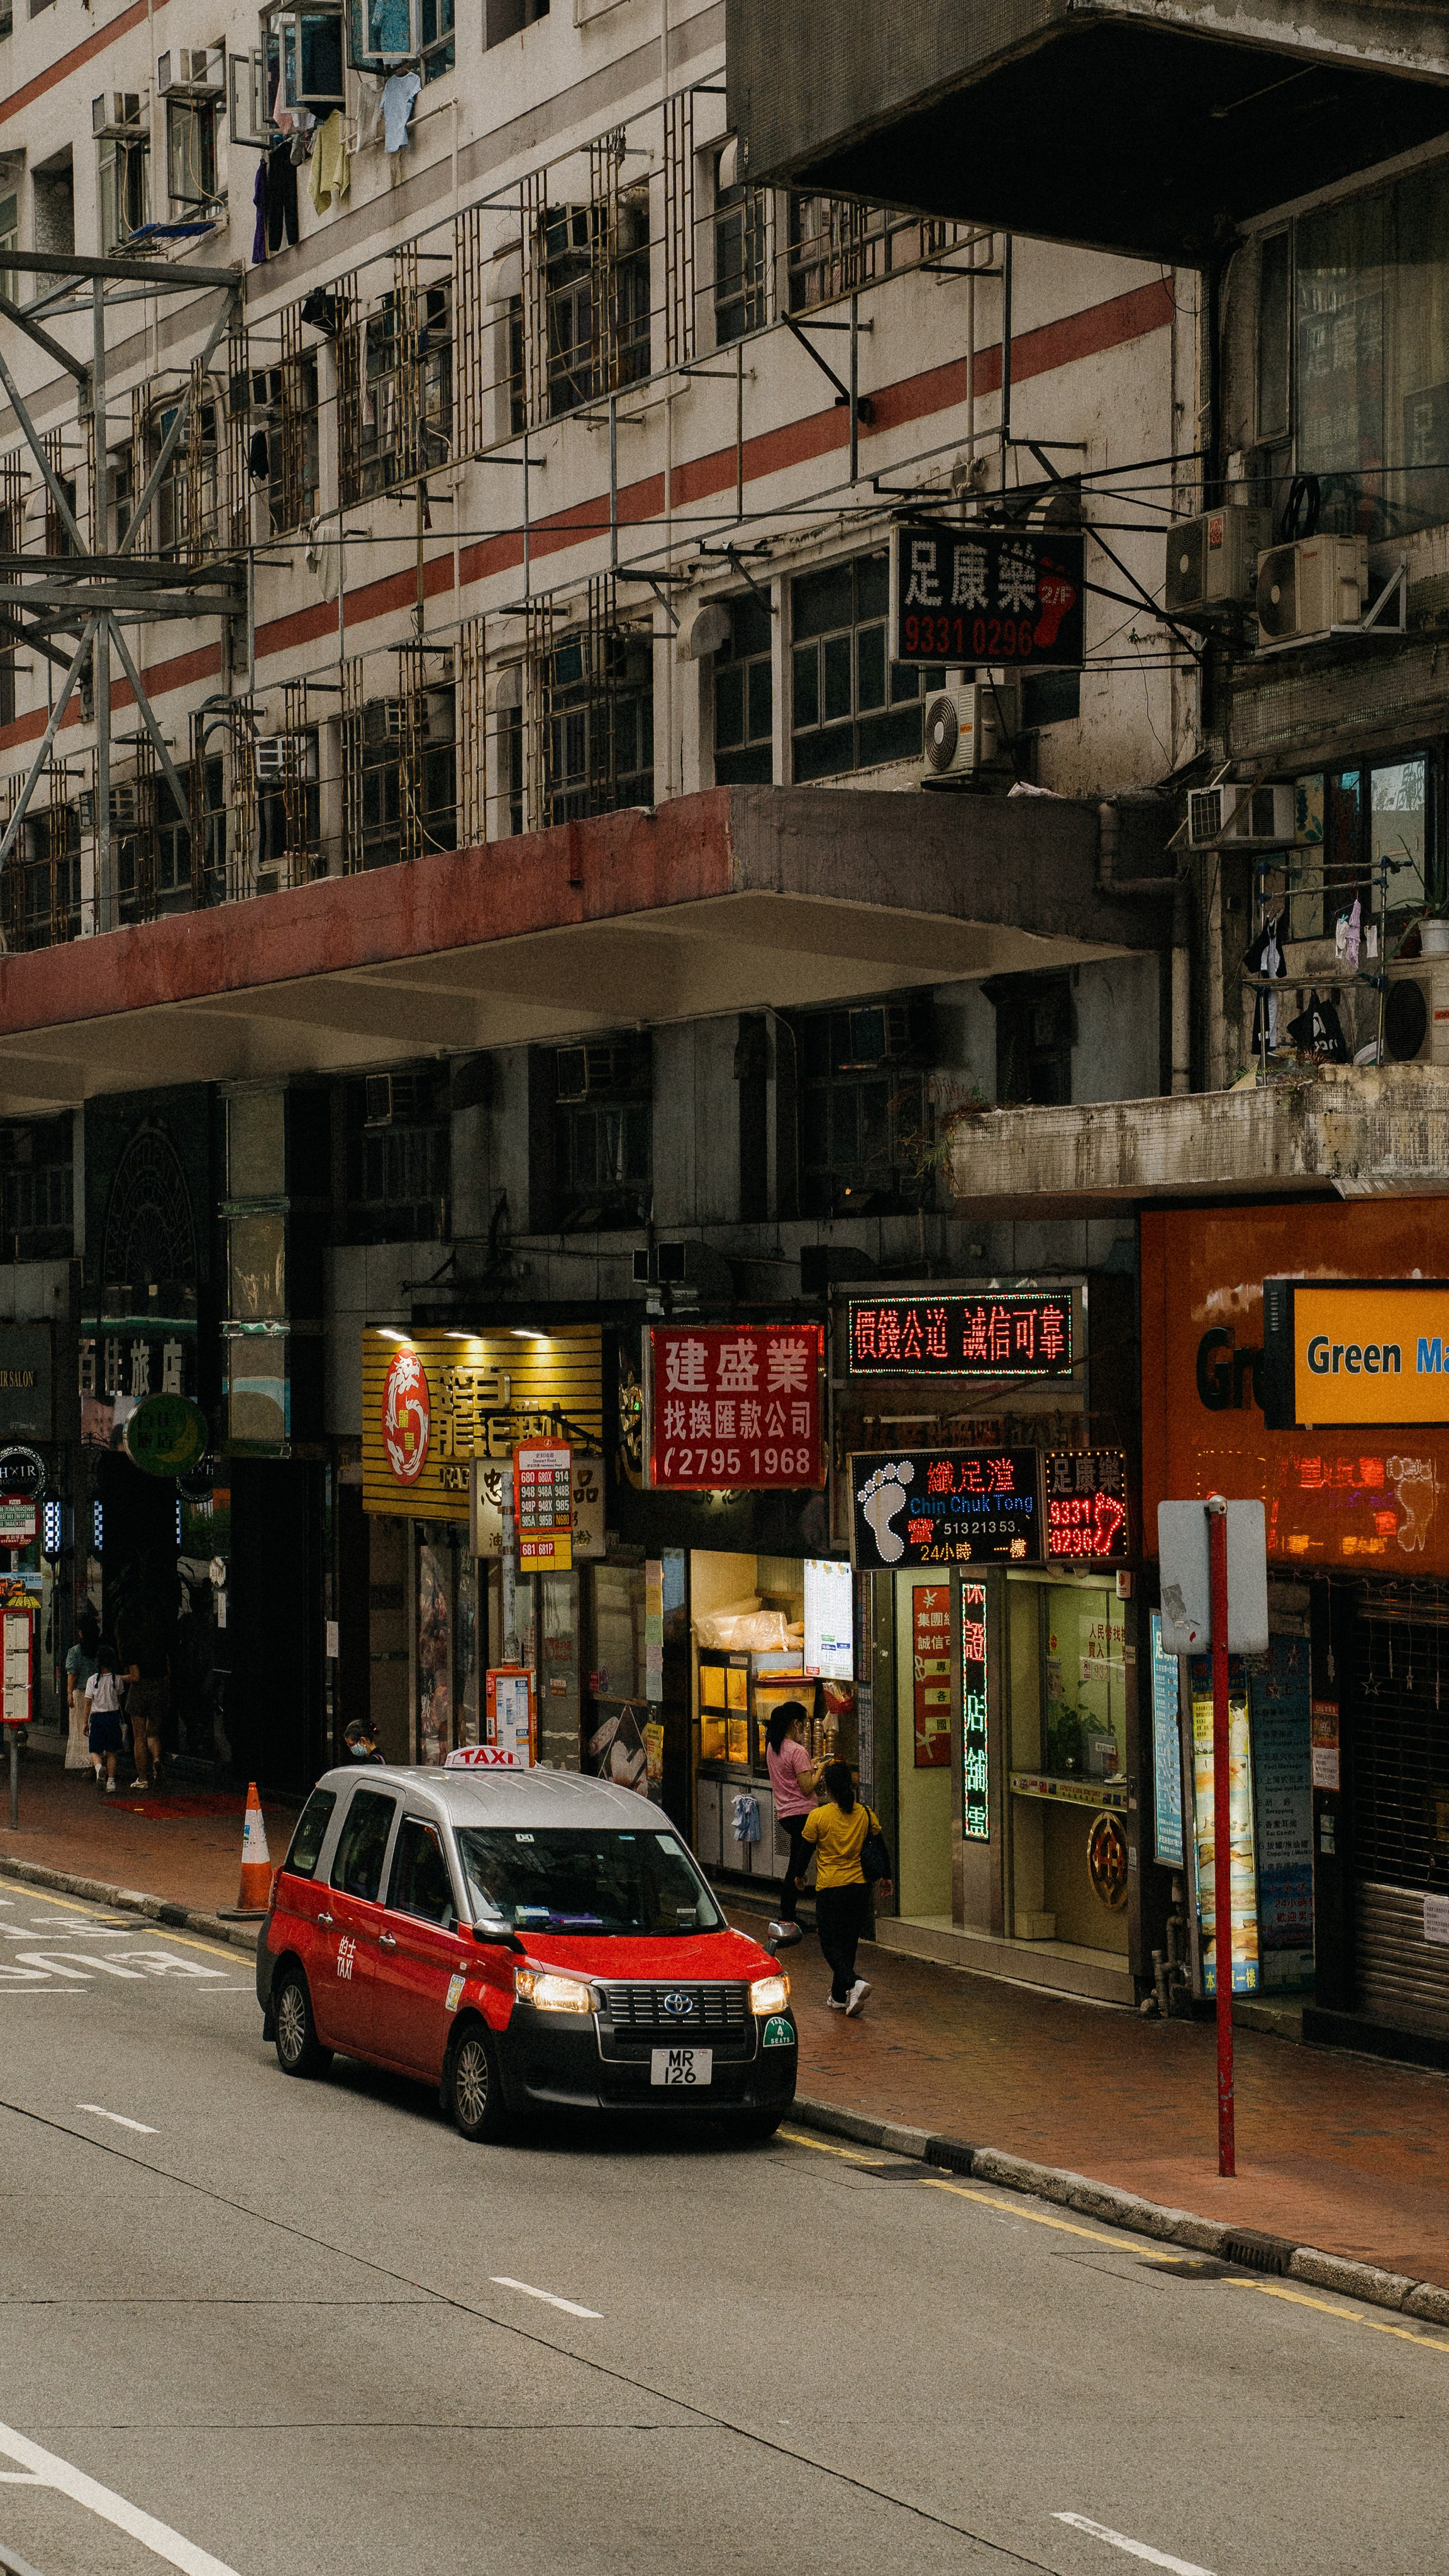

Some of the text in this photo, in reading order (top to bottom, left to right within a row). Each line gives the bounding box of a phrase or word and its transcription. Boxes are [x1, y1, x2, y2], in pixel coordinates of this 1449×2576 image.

[904, 540, 1036, 613] 足康樂
[1041, 586, 1074, 605] 2/F
[905, 616, 1032, 657] 9331 0296
[1306, 1335, 1402, 1375] Green
[79, 1337, 186, 1395] 百佳旅店
[665, 1338, 809, 1393] 建盛業
[9, 1370, 34, 1388] SALON
[664, 1399, 811, 1440] 找換匯款公司
[679, 1448, 810, 1475] 2795 1968
[521, 1470, 569, 1483] 680 680X 914
[1052, 1456, 1121, 1494] 足康樂
[521, 1484, 570, 1497] 948 948A 948B
[521, 1499, 570, 1513] 948P 948X 985
[909, 1494, 1033, 1515] Chin Chuk Tong
[1050, 1501, 1090, 1524] 9331
[521, 1514, 570, 1526] 985A 985B N680
[522, 1543, 553, 1555] 681 681P
[1052, 1528, 1092, 1553] 0296
[920, 1541, 972, 1561] 24小時
[460, 1749, 514, 1765] TAXI
[338, 1935, 357, 1959] 的士
[336, 1956, 353, 1980] TAXI
[770, 2036, 791, 2045] SEATS
[777, 2025, 784, 2037] 4
[669, 2050, 694, 2067] MR
[664, 2067, 697, 2084] 126
